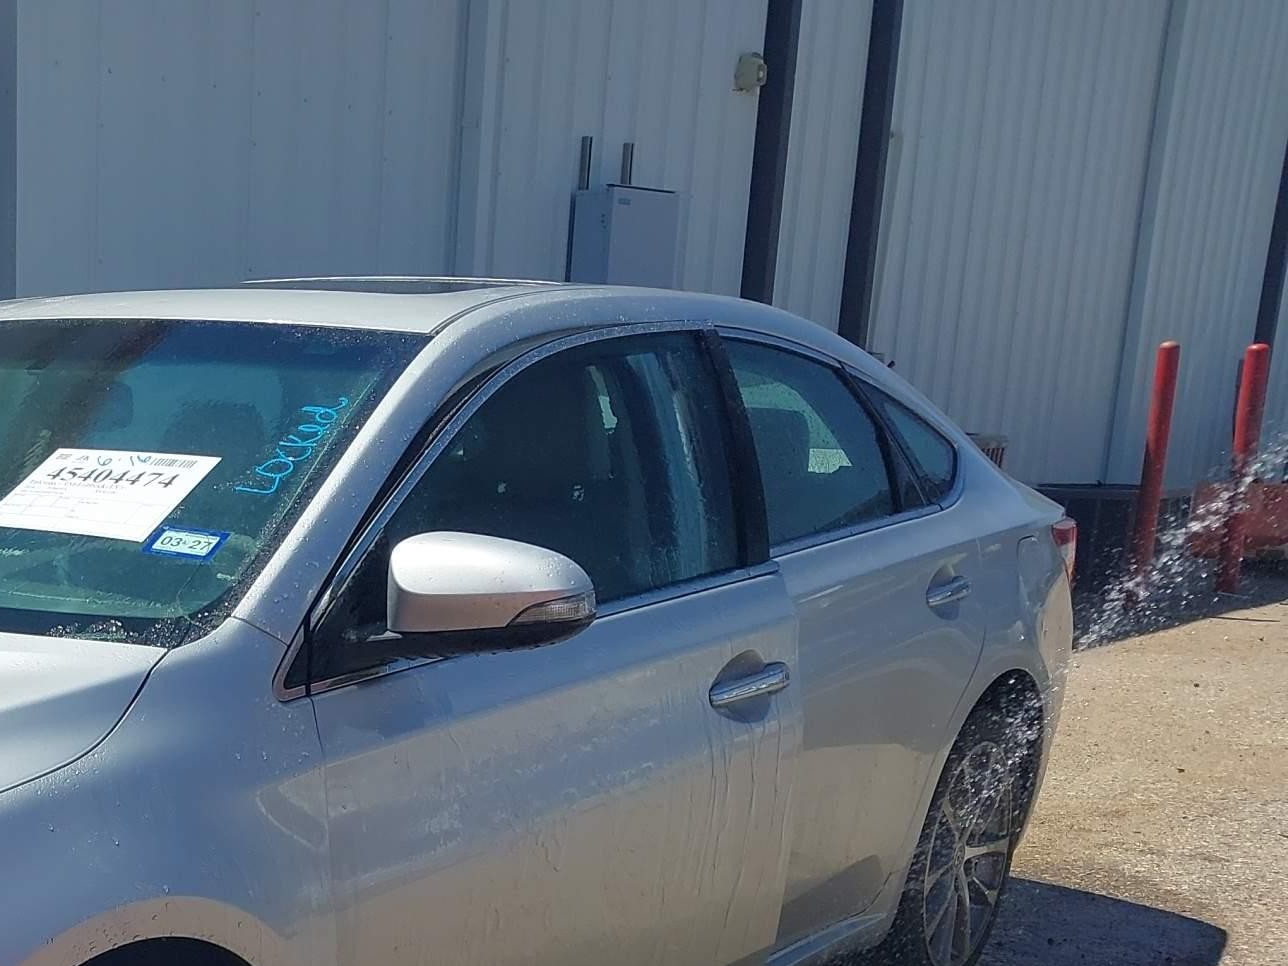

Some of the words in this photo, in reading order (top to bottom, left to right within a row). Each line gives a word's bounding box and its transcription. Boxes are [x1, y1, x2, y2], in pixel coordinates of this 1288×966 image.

[46, 466, 180, 489] 45404474
[160, 535, 183, 547] 03
[187, 540, 213, 551] 27
